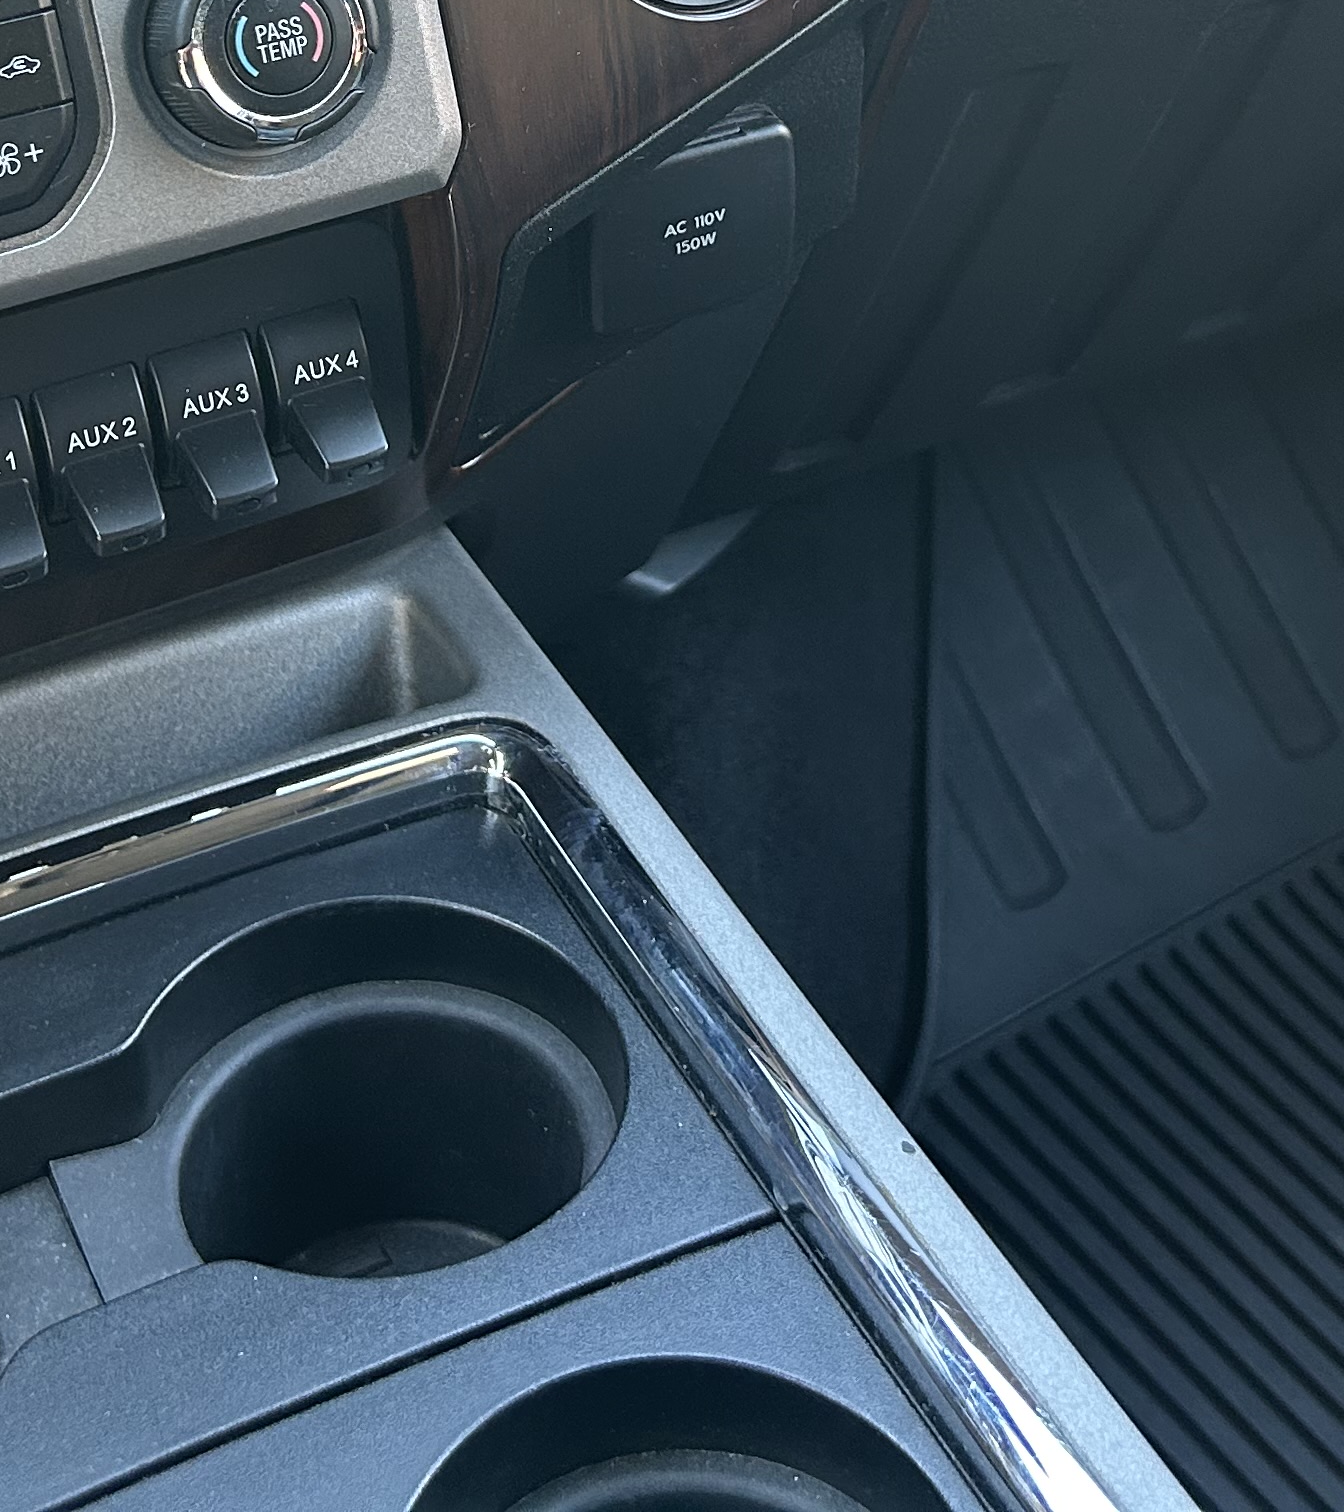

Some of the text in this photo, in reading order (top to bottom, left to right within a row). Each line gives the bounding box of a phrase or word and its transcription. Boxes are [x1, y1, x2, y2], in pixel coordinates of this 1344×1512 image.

[255, 16, 303, 43] PASS
[256, 35, 308, 64] TEMP
[663, 207, 726, 238] AC 110V
[675, 231, 717, 255] 150W
[293, 349, 359, 385] AUX 4
[182, 382, 250, 419] AUX 3
[67, 416, 138, 454] AUX 2
[5, 450, 18, 471] 1
